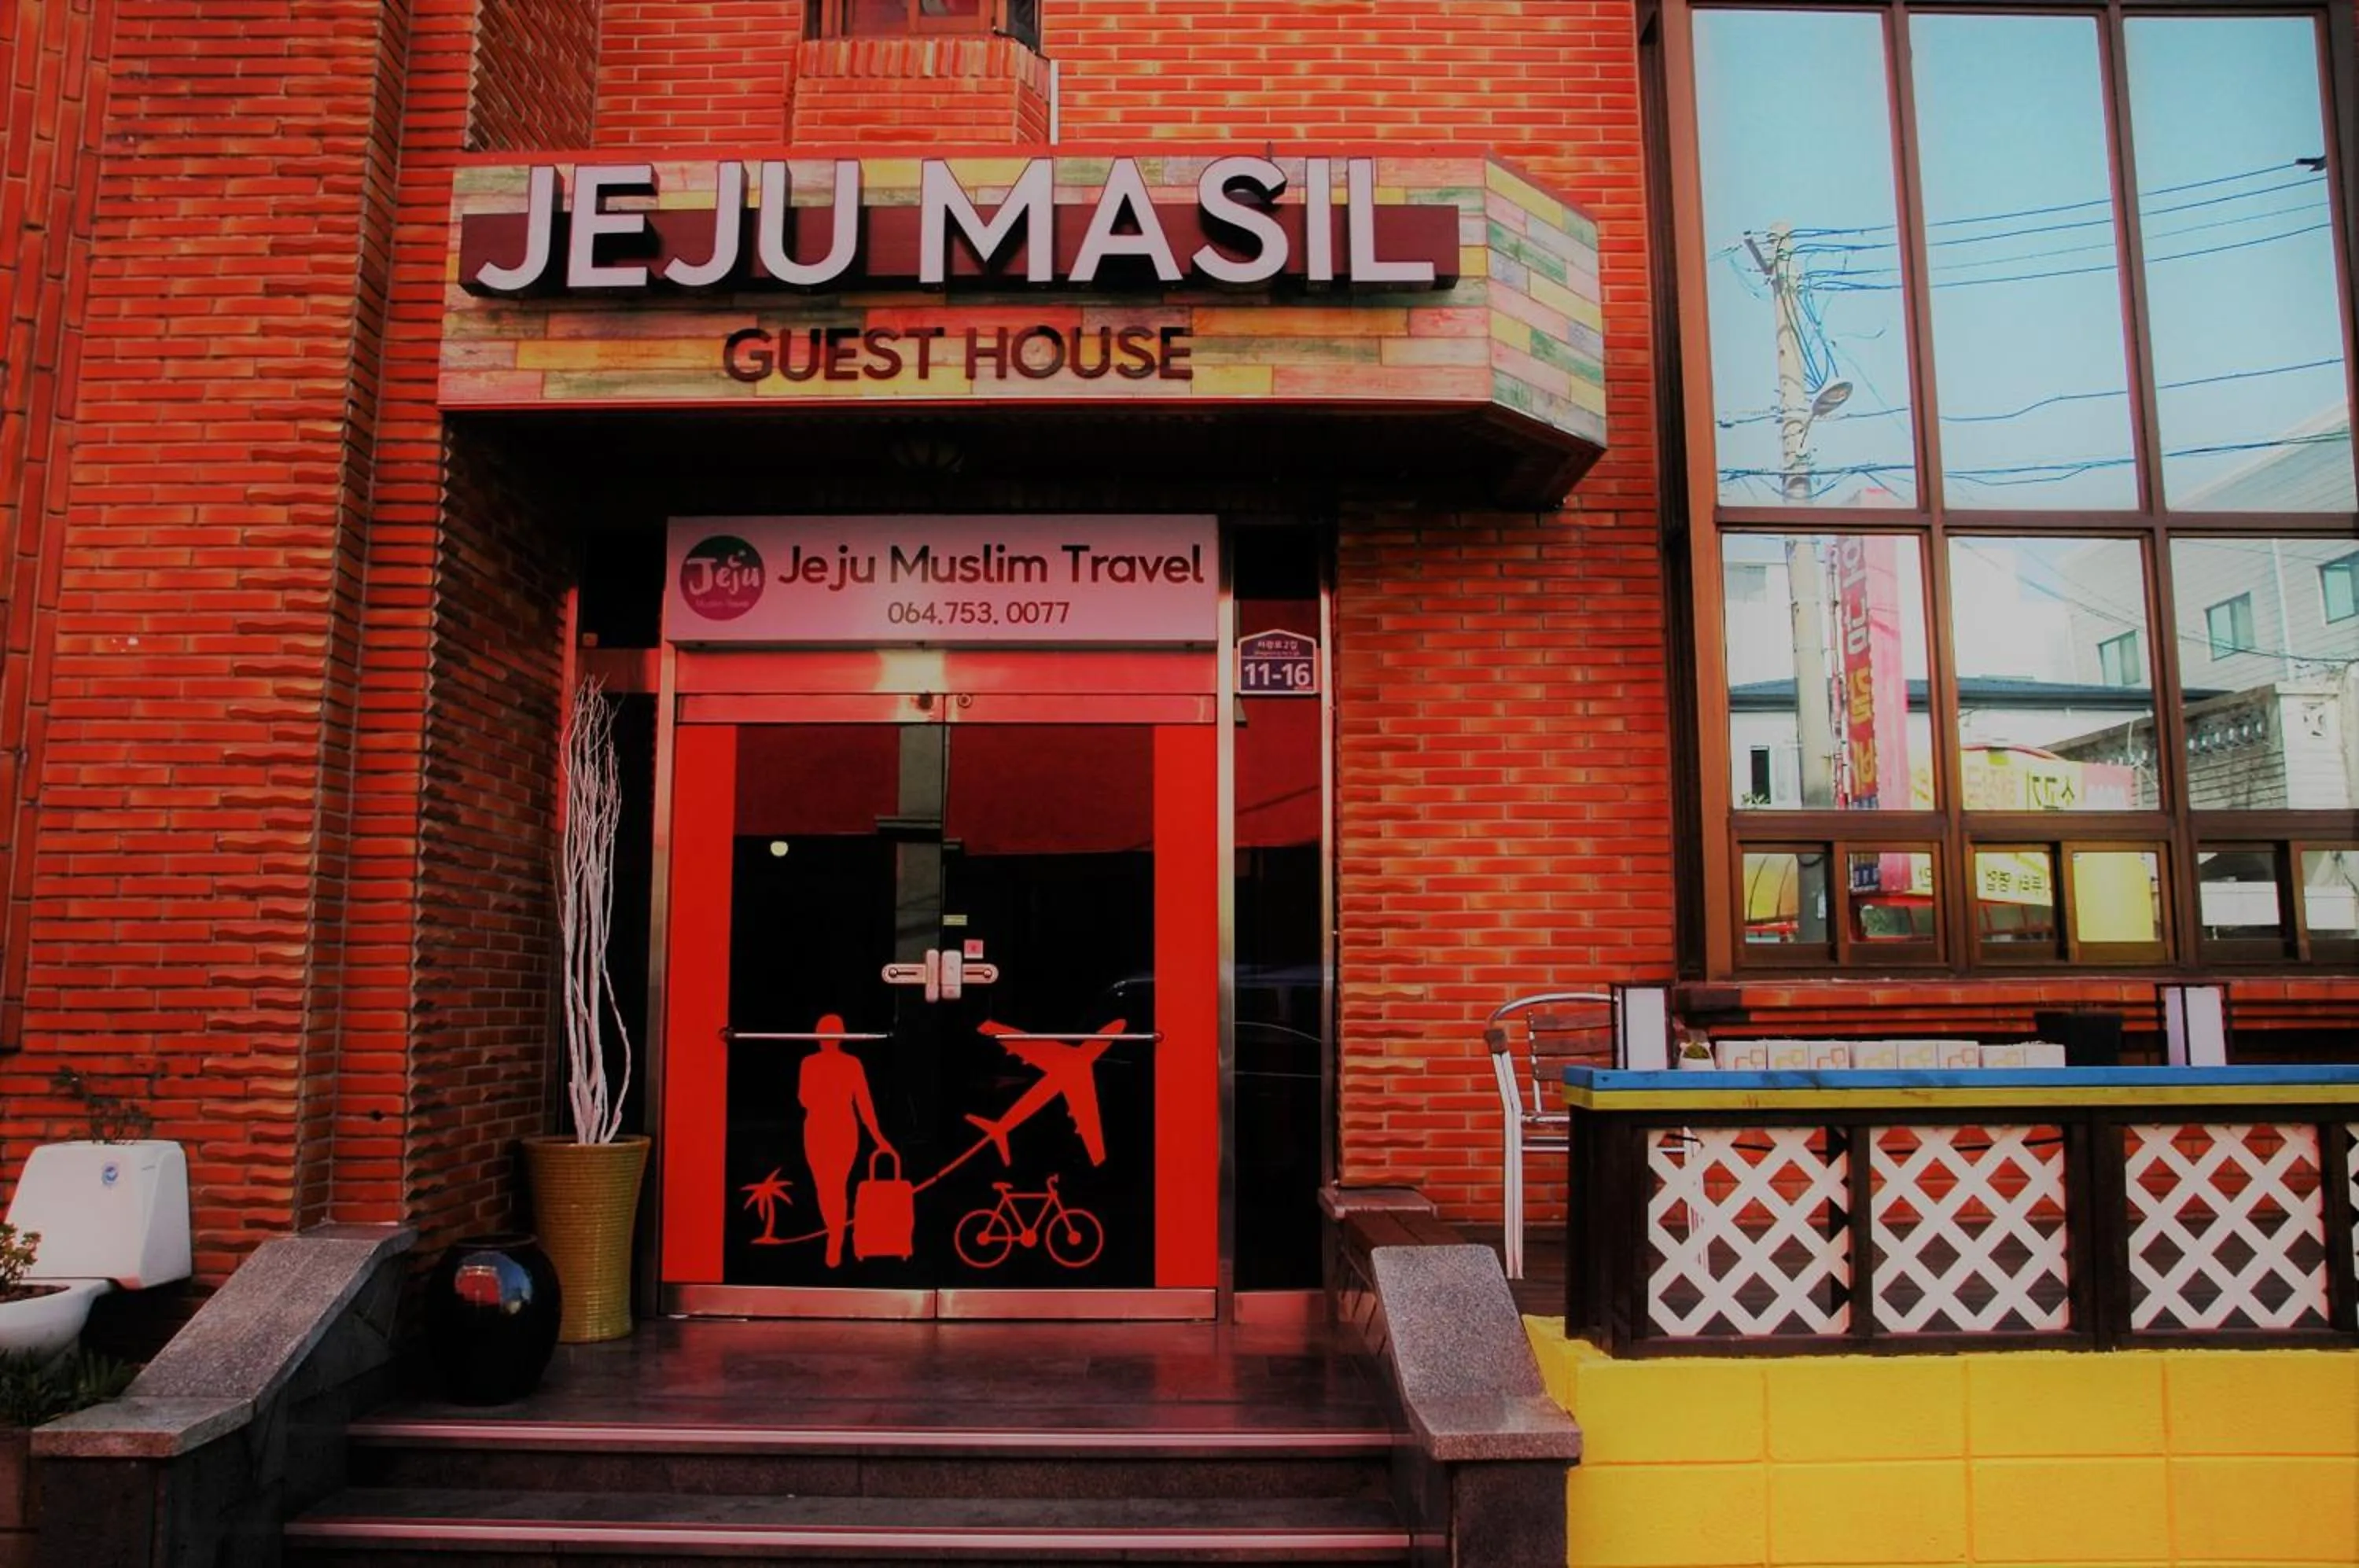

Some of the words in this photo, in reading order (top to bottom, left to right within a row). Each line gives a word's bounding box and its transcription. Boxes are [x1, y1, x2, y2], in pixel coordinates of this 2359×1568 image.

[476, 160, 863, 291] JEJU
[918, 155, 1436, 284] MASIL
[723, 326, 944, 382] GUEST
[964, 324, 1194, 381] HOUSE
[686, 552, 760, 596] Jeju
[778, 544, 875, 591] Jeju
[889, 544, 1048, 584] Muslim
[1061, 543, 1205, 584] Travel
[1244, 663, 1311, 686] 11-16
